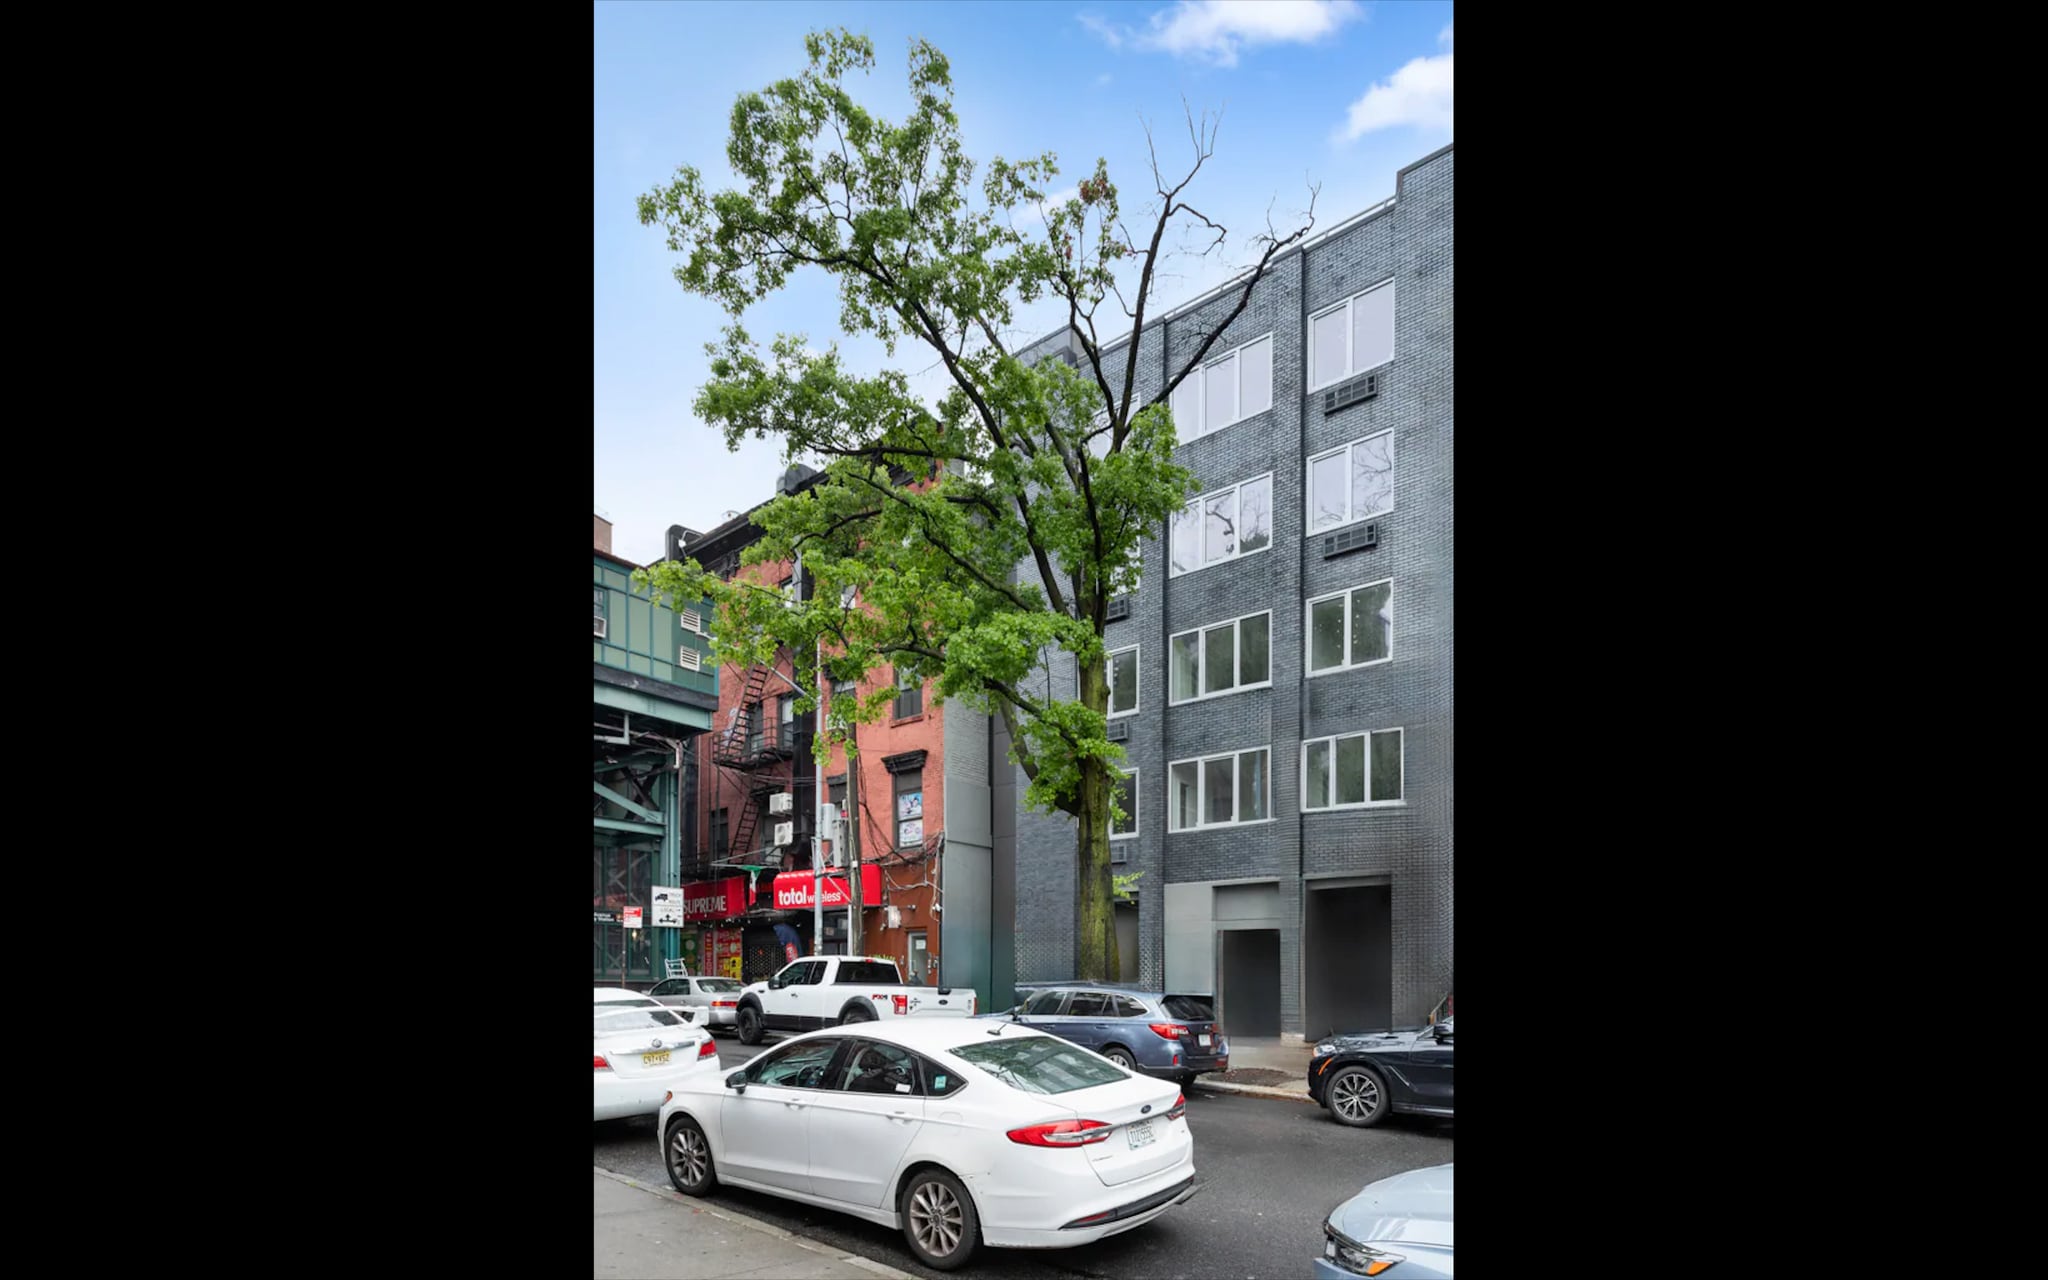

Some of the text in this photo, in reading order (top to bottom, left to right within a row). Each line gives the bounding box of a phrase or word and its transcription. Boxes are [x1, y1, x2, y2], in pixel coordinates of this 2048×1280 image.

[683, 895, 727, 914] SUPREME
[778, 885, 841, 906] total wieless
